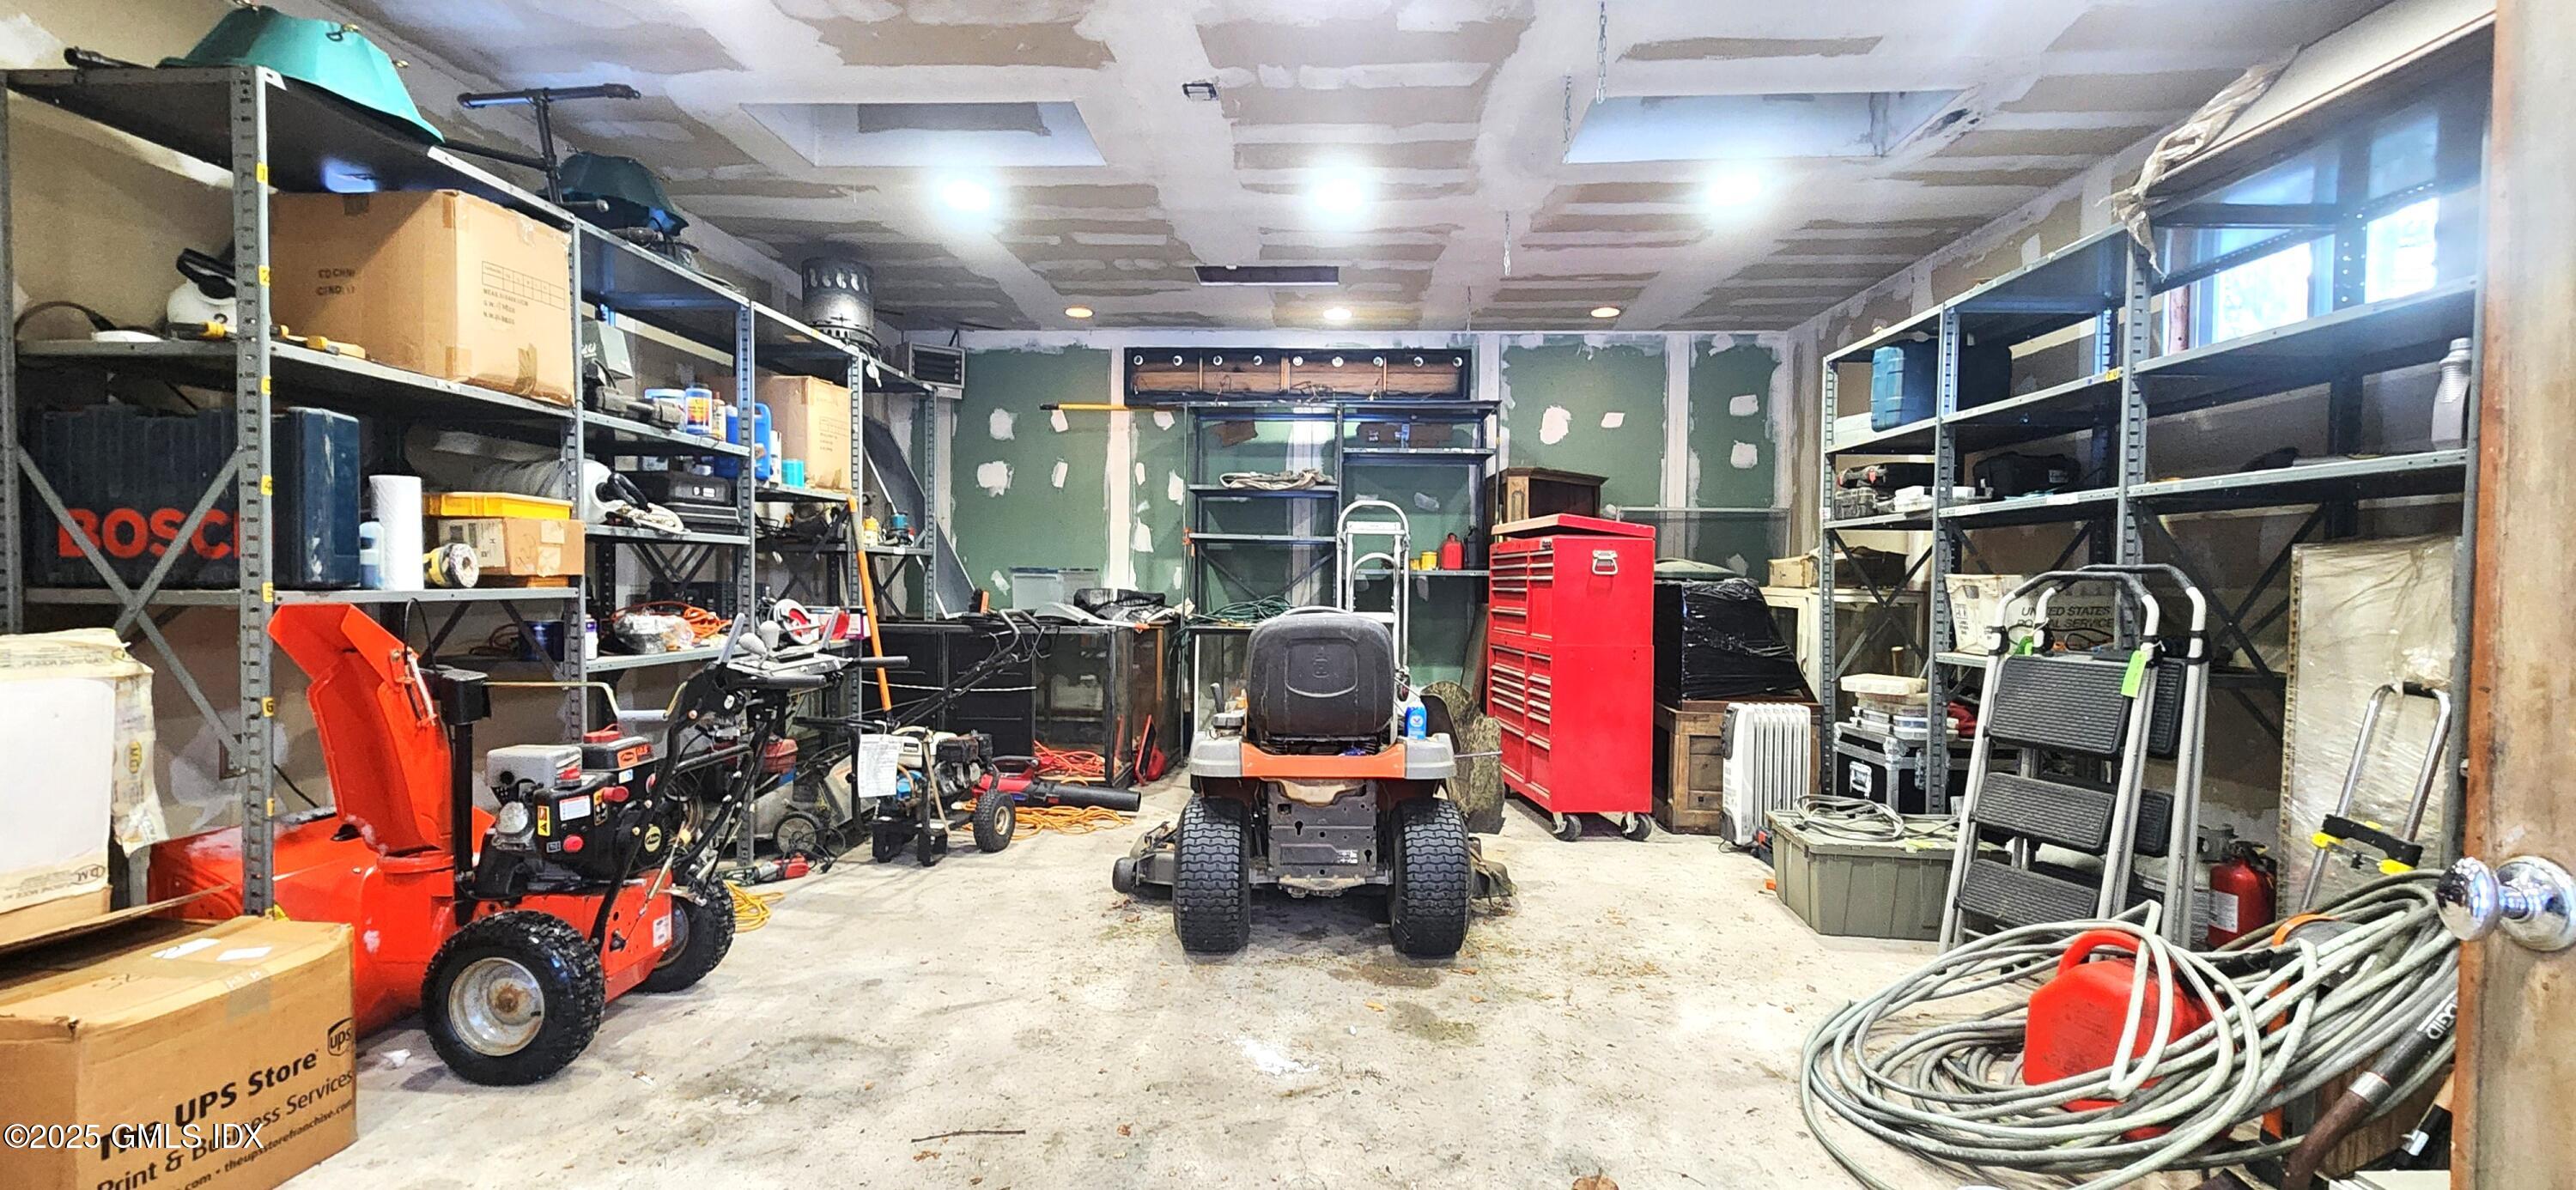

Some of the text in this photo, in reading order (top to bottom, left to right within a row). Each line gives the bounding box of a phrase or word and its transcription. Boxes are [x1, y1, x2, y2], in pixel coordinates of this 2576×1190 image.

[58, 508, 274, 559] BOSC
[2021, 606, 2111, 616] UNED STATES
[2065, 618, 2115, 628] SERVICE
[175, 1082, 237, 1127] UPS
[247, 1053, 317, 1097] Store
[165, 1150, 185, 1173] &
[286, 1071, 353, 1115] Services
